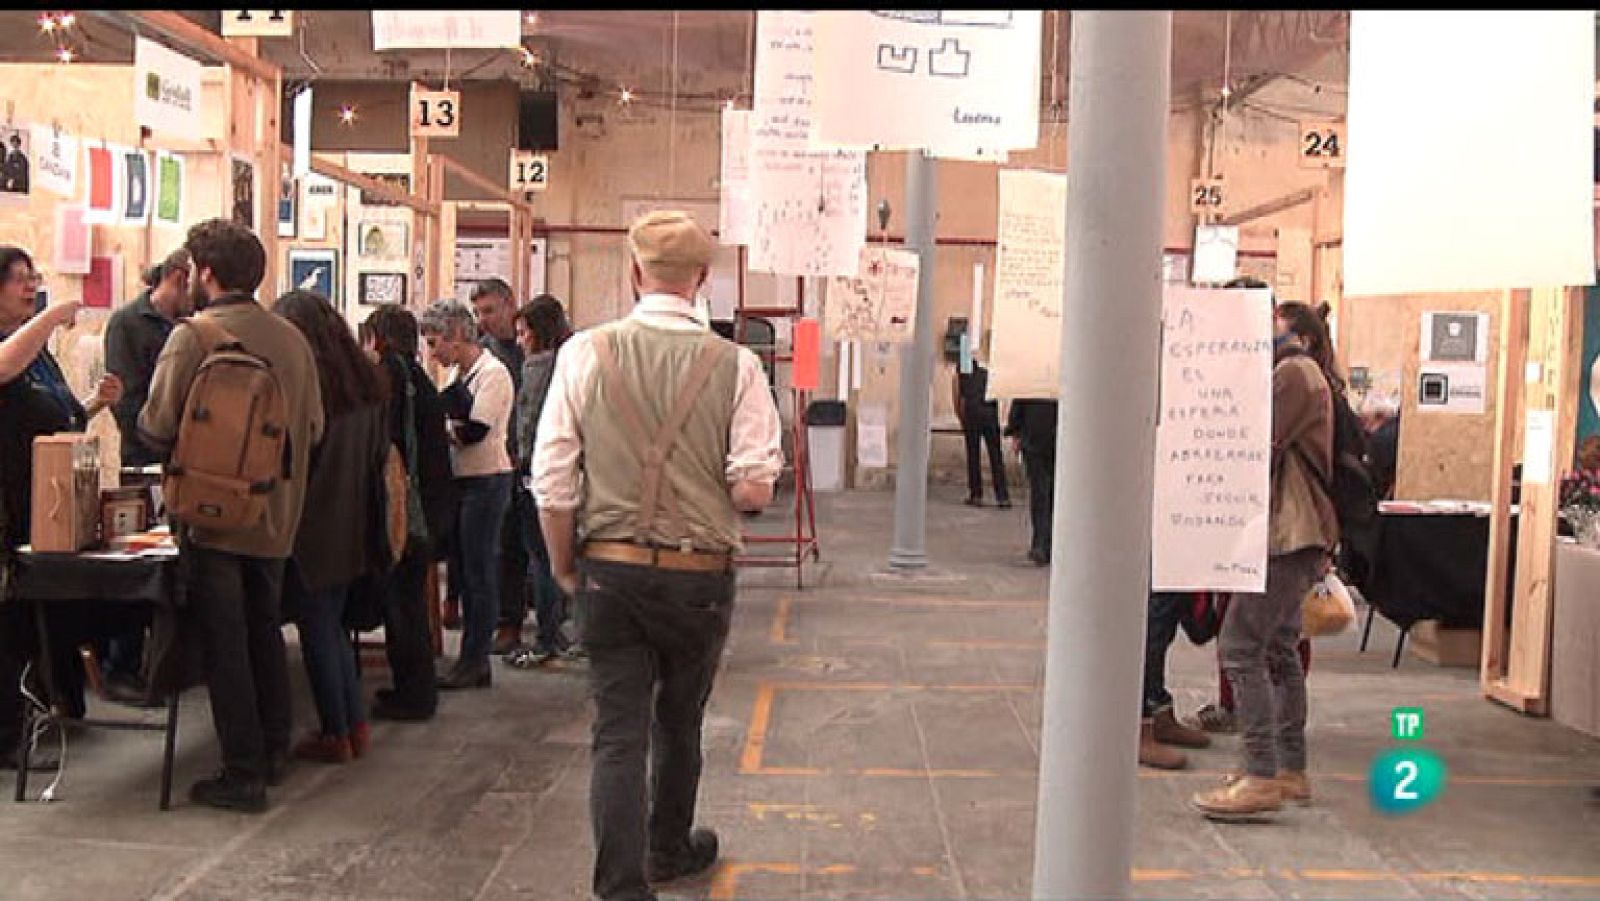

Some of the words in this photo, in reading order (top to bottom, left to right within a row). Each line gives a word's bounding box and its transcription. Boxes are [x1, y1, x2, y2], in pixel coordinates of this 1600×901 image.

[419, 100, 455, 127] 13
[1304, 131, 1339, 157] 24
[516, 162, 545, 183] 12
